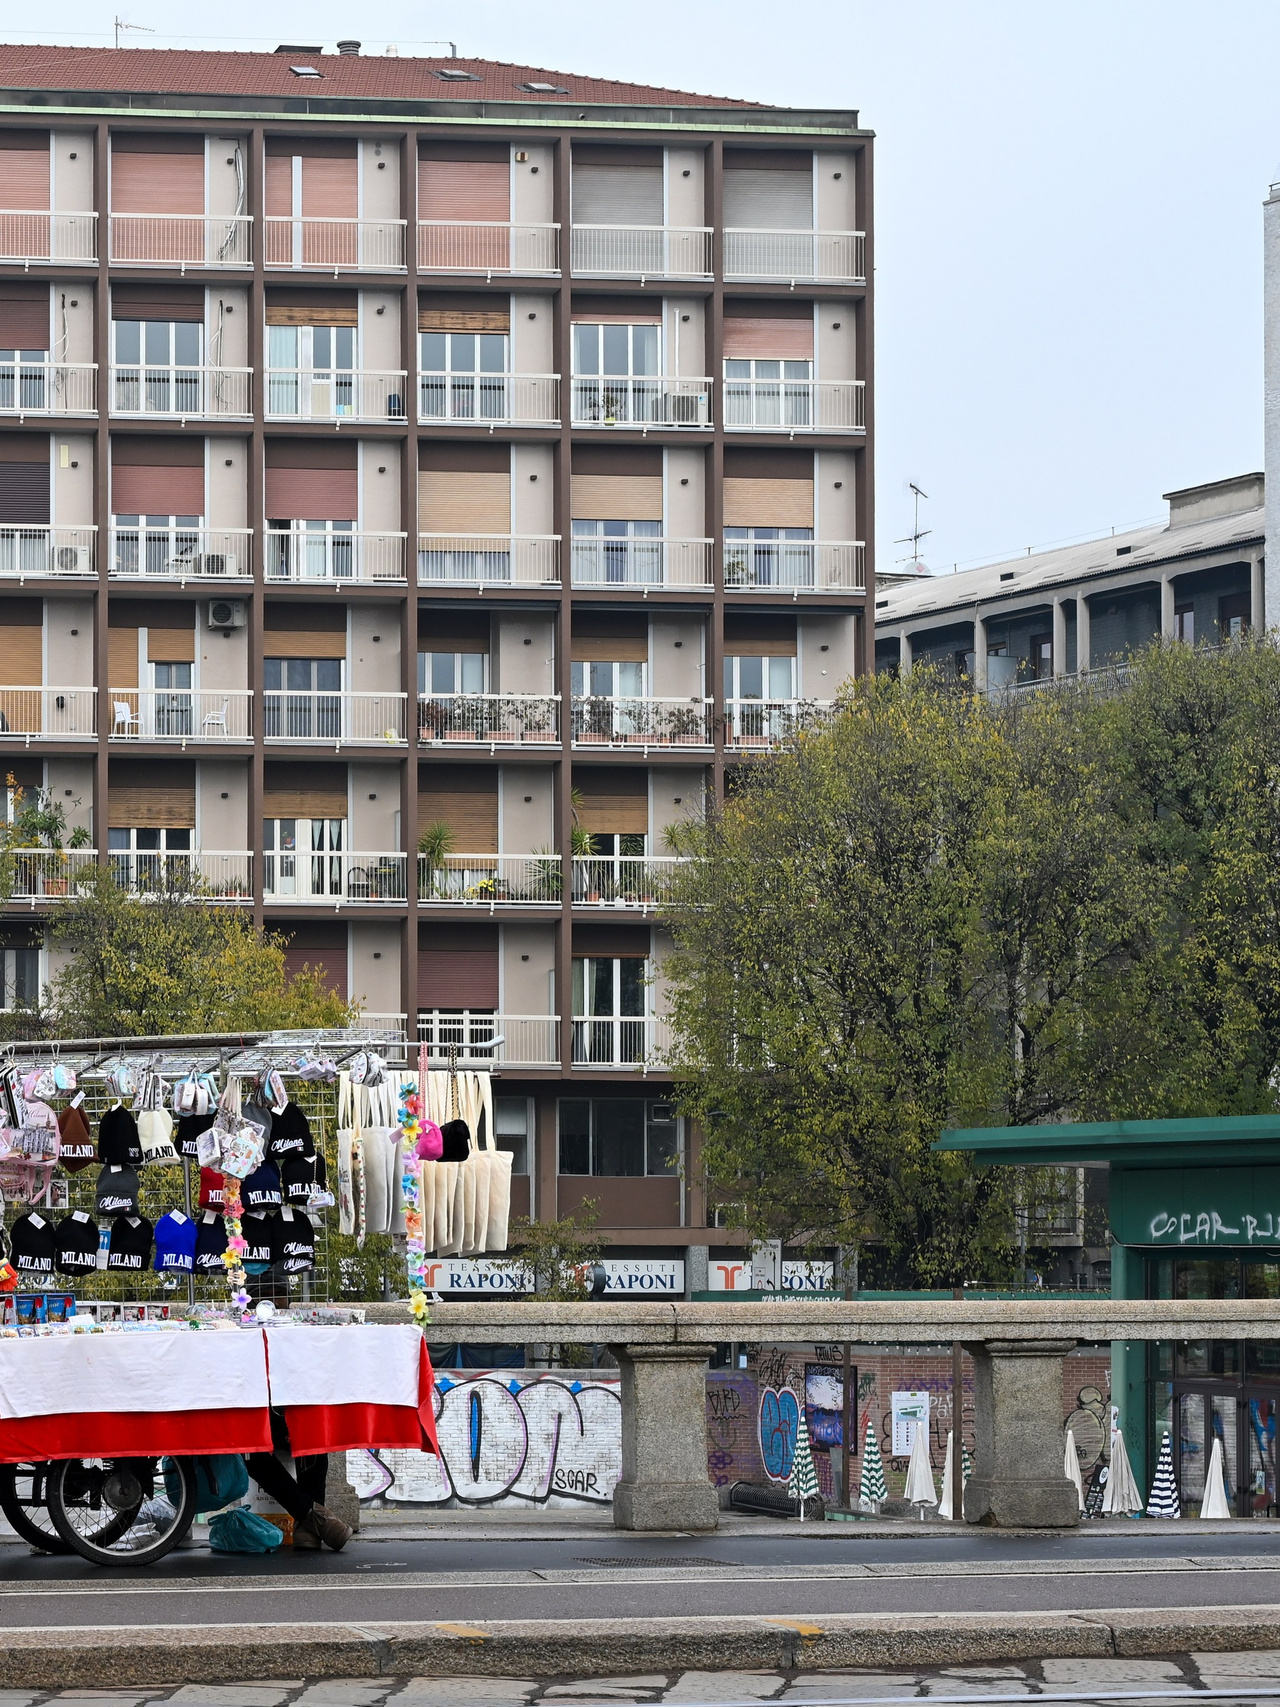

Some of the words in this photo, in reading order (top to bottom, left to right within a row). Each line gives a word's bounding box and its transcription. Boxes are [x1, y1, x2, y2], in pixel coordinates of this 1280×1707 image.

[60, 1144, 94, 1157] MILANO
[181, 1141, 199, 1154] MIL
[271, 1138, 305, 1152] Milano
[144, 1146, 174, 1163] MILANO
[100, 1196, 133, 1209] Milano
[208, 1189, 224, 1203] MIL
[248, 1190, 282, 1205] MILANO
[283, 1242, 314, 1255] Milano
[17, 1255, 52, 1271] MILANO
[61, 1251, 96, 1267] MILANO
[109, 1253, 142, 1268] MILANO
[162, 1253, 193, 1269] MILANO
